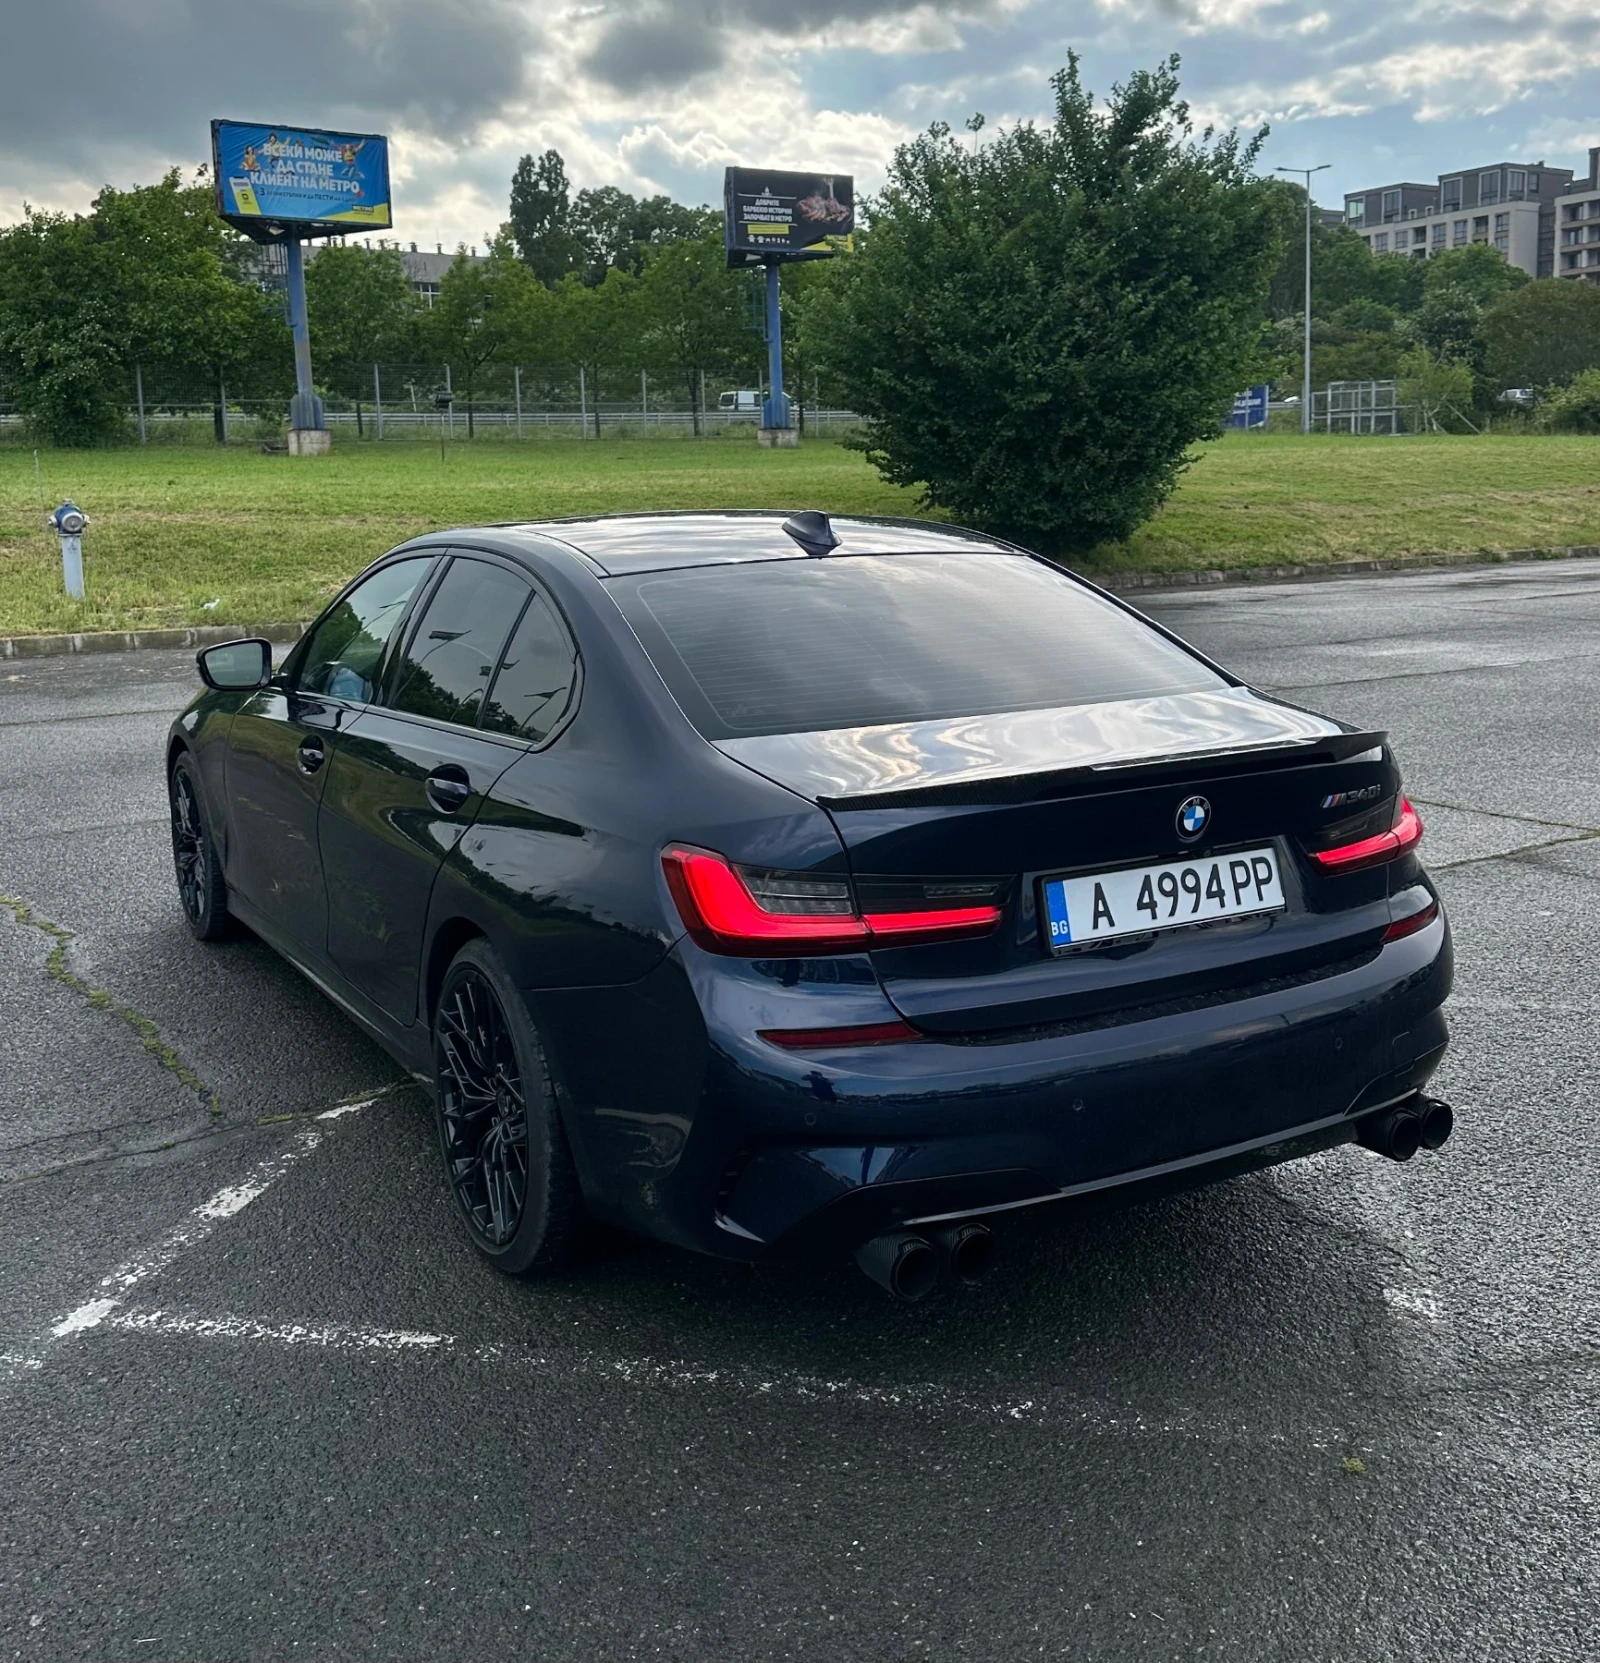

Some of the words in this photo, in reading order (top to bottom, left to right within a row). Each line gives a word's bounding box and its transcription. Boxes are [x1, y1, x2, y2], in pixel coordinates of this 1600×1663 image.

[263, 144, 303, 158] ВСЕКИ
[305, 147, 343, 162] МОЖЕ
[276, 160, 295, 174] ДА
[296, 161, 334, 176] СТАНЕ
[251, 172, 299, 187] КЛИЕНТ
[300, 177, 318, 189] НА
[319, 177, 360, 193] МЕТРО
[314, 193, 333, 201] ПЕСТИ
[755, 198, 780, 206] ДОБРИТЕ
[742, 205, 768, 213] БАРБЕКЮ
[768, 207, 793, 215] ИСТОРИИ
[774, 215, 793, 223] МЕТРО
[1092, 882, 1115, 930] A
[1136, 856, 1273, 920] 4994PP
[1050, 919, 1068, 937] BG
